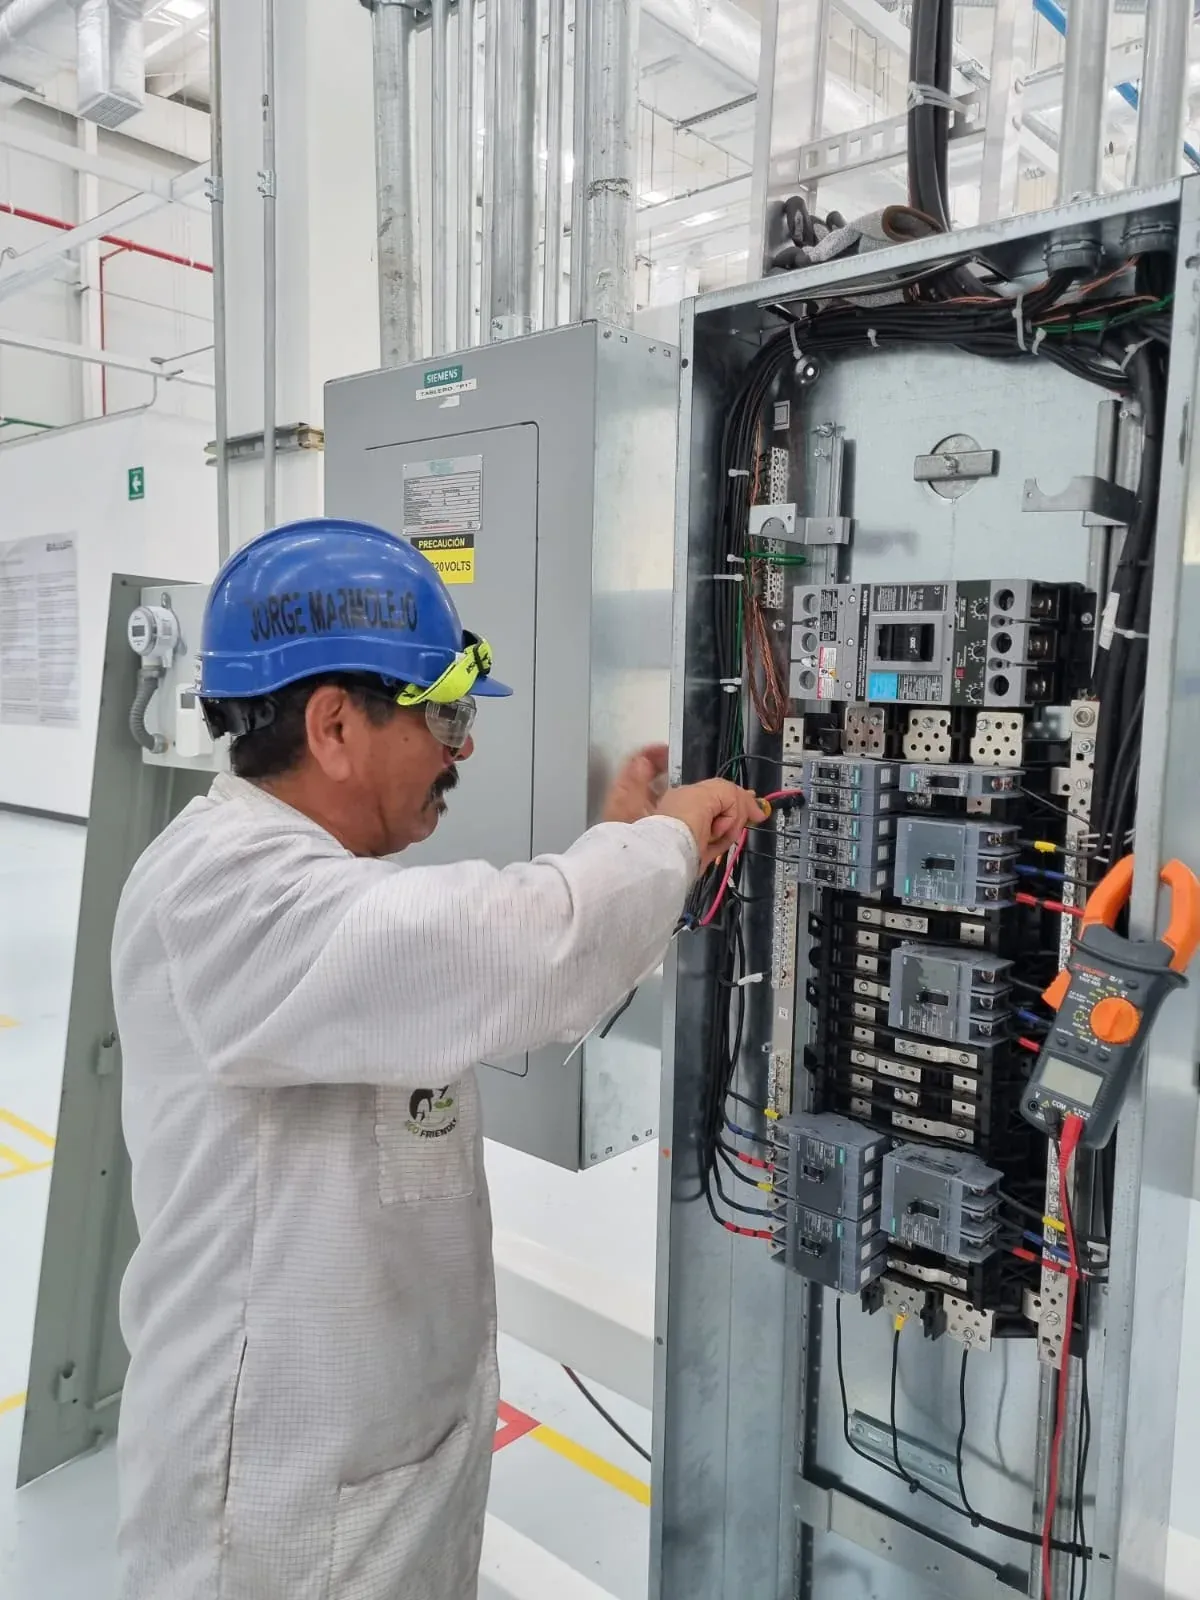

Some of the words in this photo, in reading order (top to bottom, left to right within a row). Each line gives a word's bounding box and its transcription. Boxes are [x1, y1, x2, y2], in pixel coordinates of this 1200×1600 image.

[426, 368, 458, 384] SIEMENS
[418, 536, 465, 549] PRECAUCIÓN
[445, 561, 471, 572] VOLTS
[251, 592, 307, 642] JORGE
